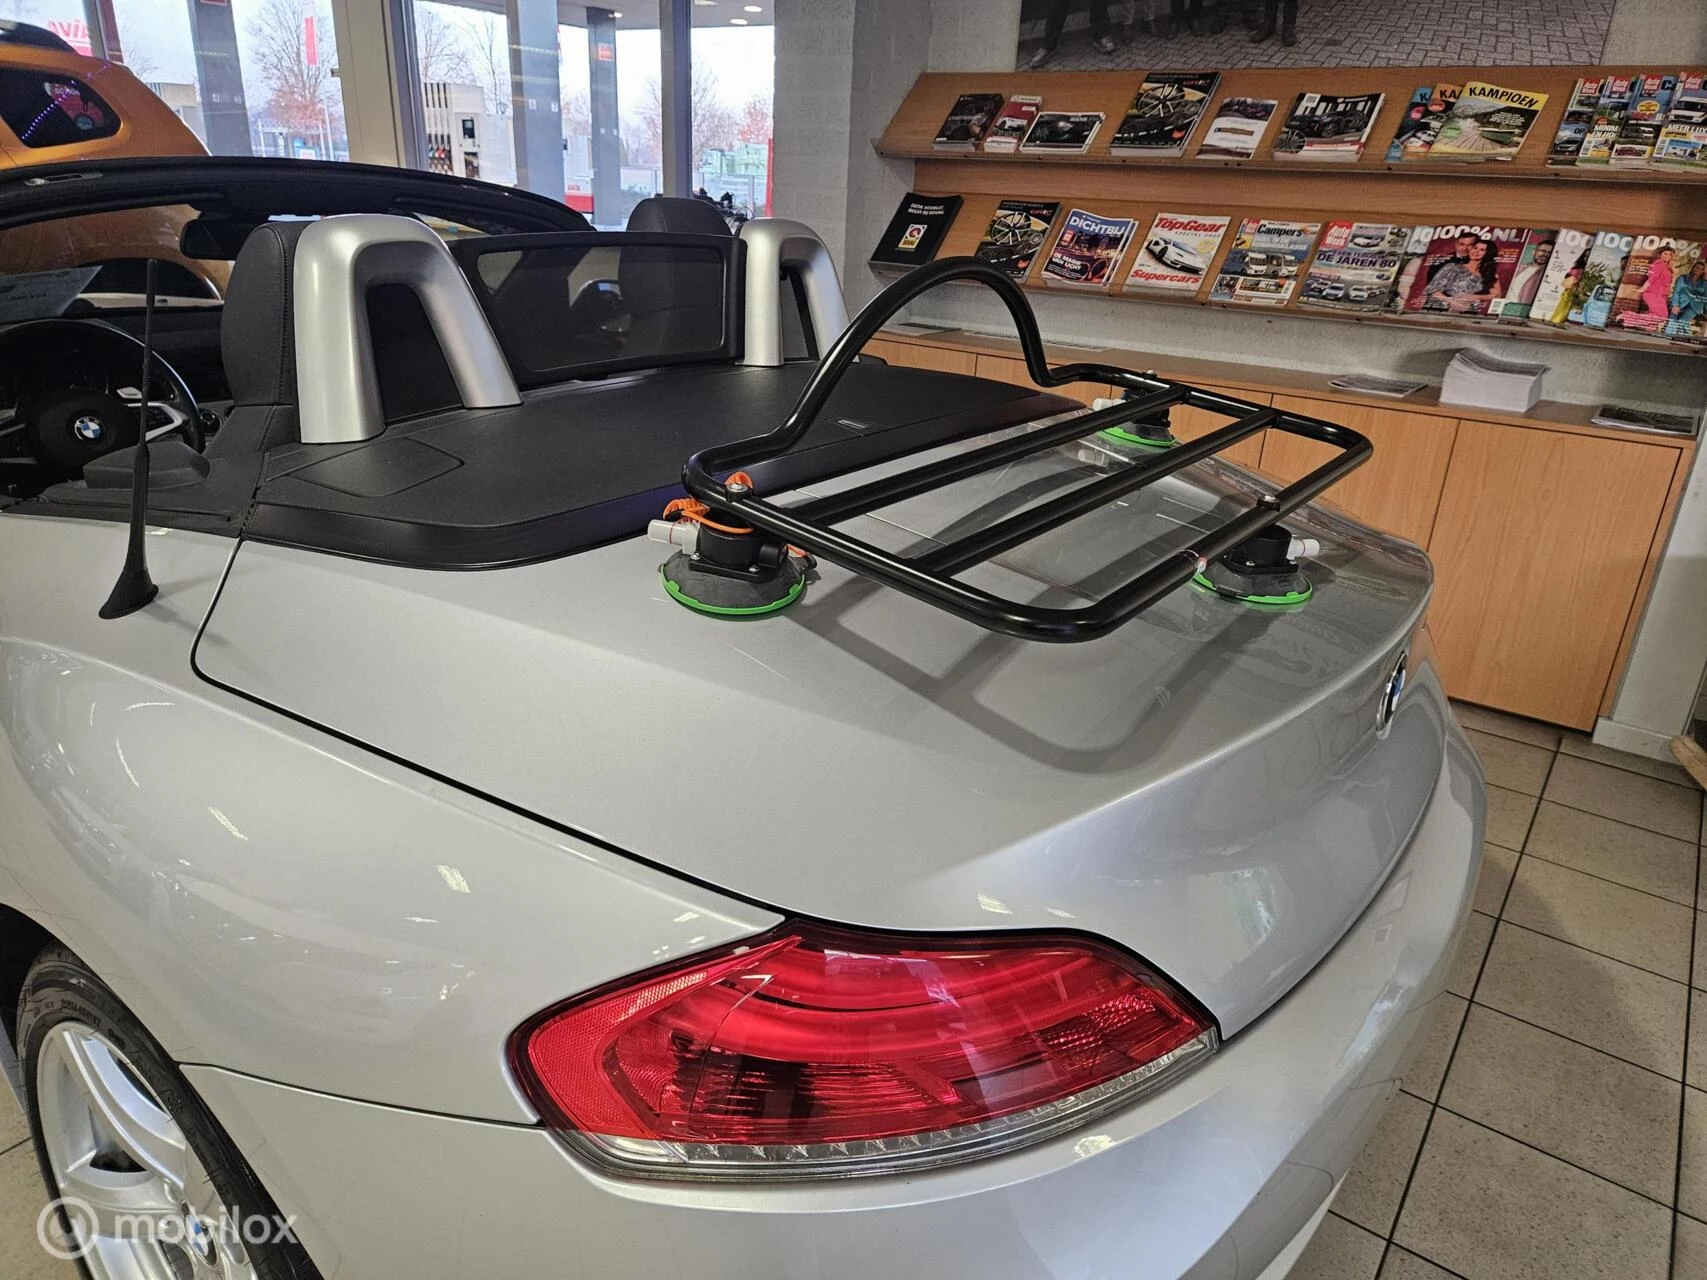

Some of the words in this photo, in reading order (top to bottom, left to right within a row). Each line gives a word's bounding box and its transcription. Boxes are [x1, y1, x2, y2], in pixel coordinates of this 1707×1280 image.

[1469, 86, 1538, 108] KAMPIOEN
[1069, 216, 1125, 234] DICHTBIJ
[1154, 217, 1226, 233] TopGear
[1257, 223, 1304, 237] Campers
[1327, 225, 1351, 236] Auto
[1317, 253, 1334, 262] DE
[1336, 256, 1377, 267] JAREN
[1379, 260, 1397, 268] 80
[1131, 269, 1202, 284] Supercars
